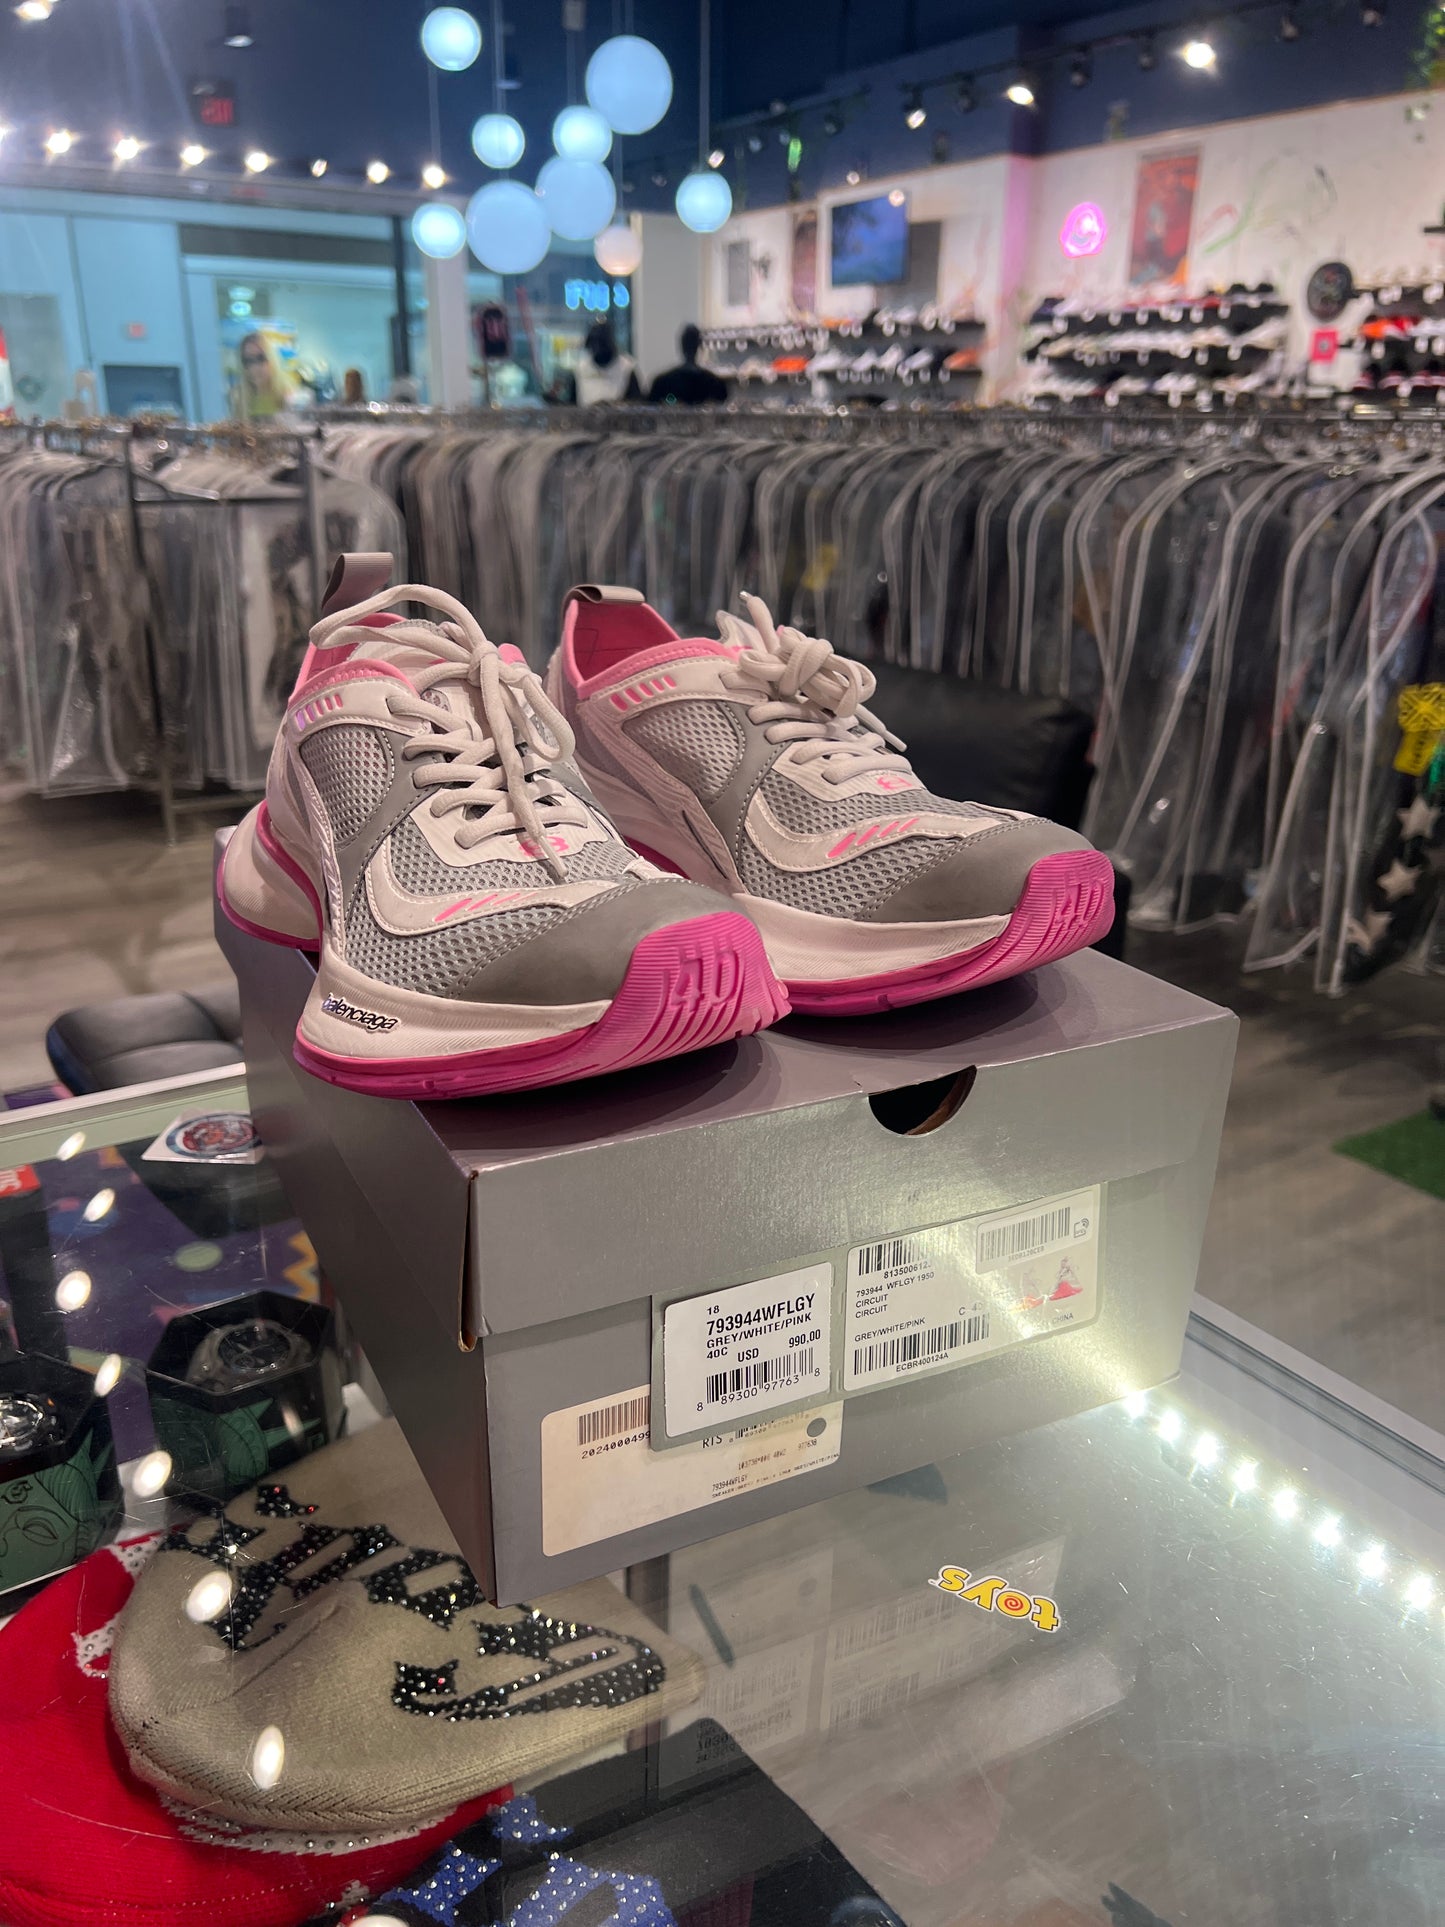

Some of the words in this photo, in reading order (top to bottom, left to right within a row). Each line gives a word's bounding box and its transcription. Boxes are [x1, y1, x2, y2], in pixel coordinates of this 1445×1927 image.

[856, 1285, 883, 1298] 793944
[886, 1275, 916, 1290] WFLGY
[917, 1271, 935, 1282] 1950
[707, 1305, 720, 1316] 18
[855, 1294, 888, 1309] CIRCUIT
[855, 1304, 888, 1319] CIRCUIT
[706, 1293, 815, 1335] 793944WFLGY
[706, 1312, 812, 1349] GREY/WHITE/PINK
[788, 1328, 821, 1348] 990.00
[854, 1317, 926, 1342] GREY/WHITE/PINK
[706, 1346, 728, 1360] 40C
[737, 1347, 760, 1362] USD
[896, 1353, 949, 1373] ECBR400124A
[937, 1566, 1060, 1632] toys
